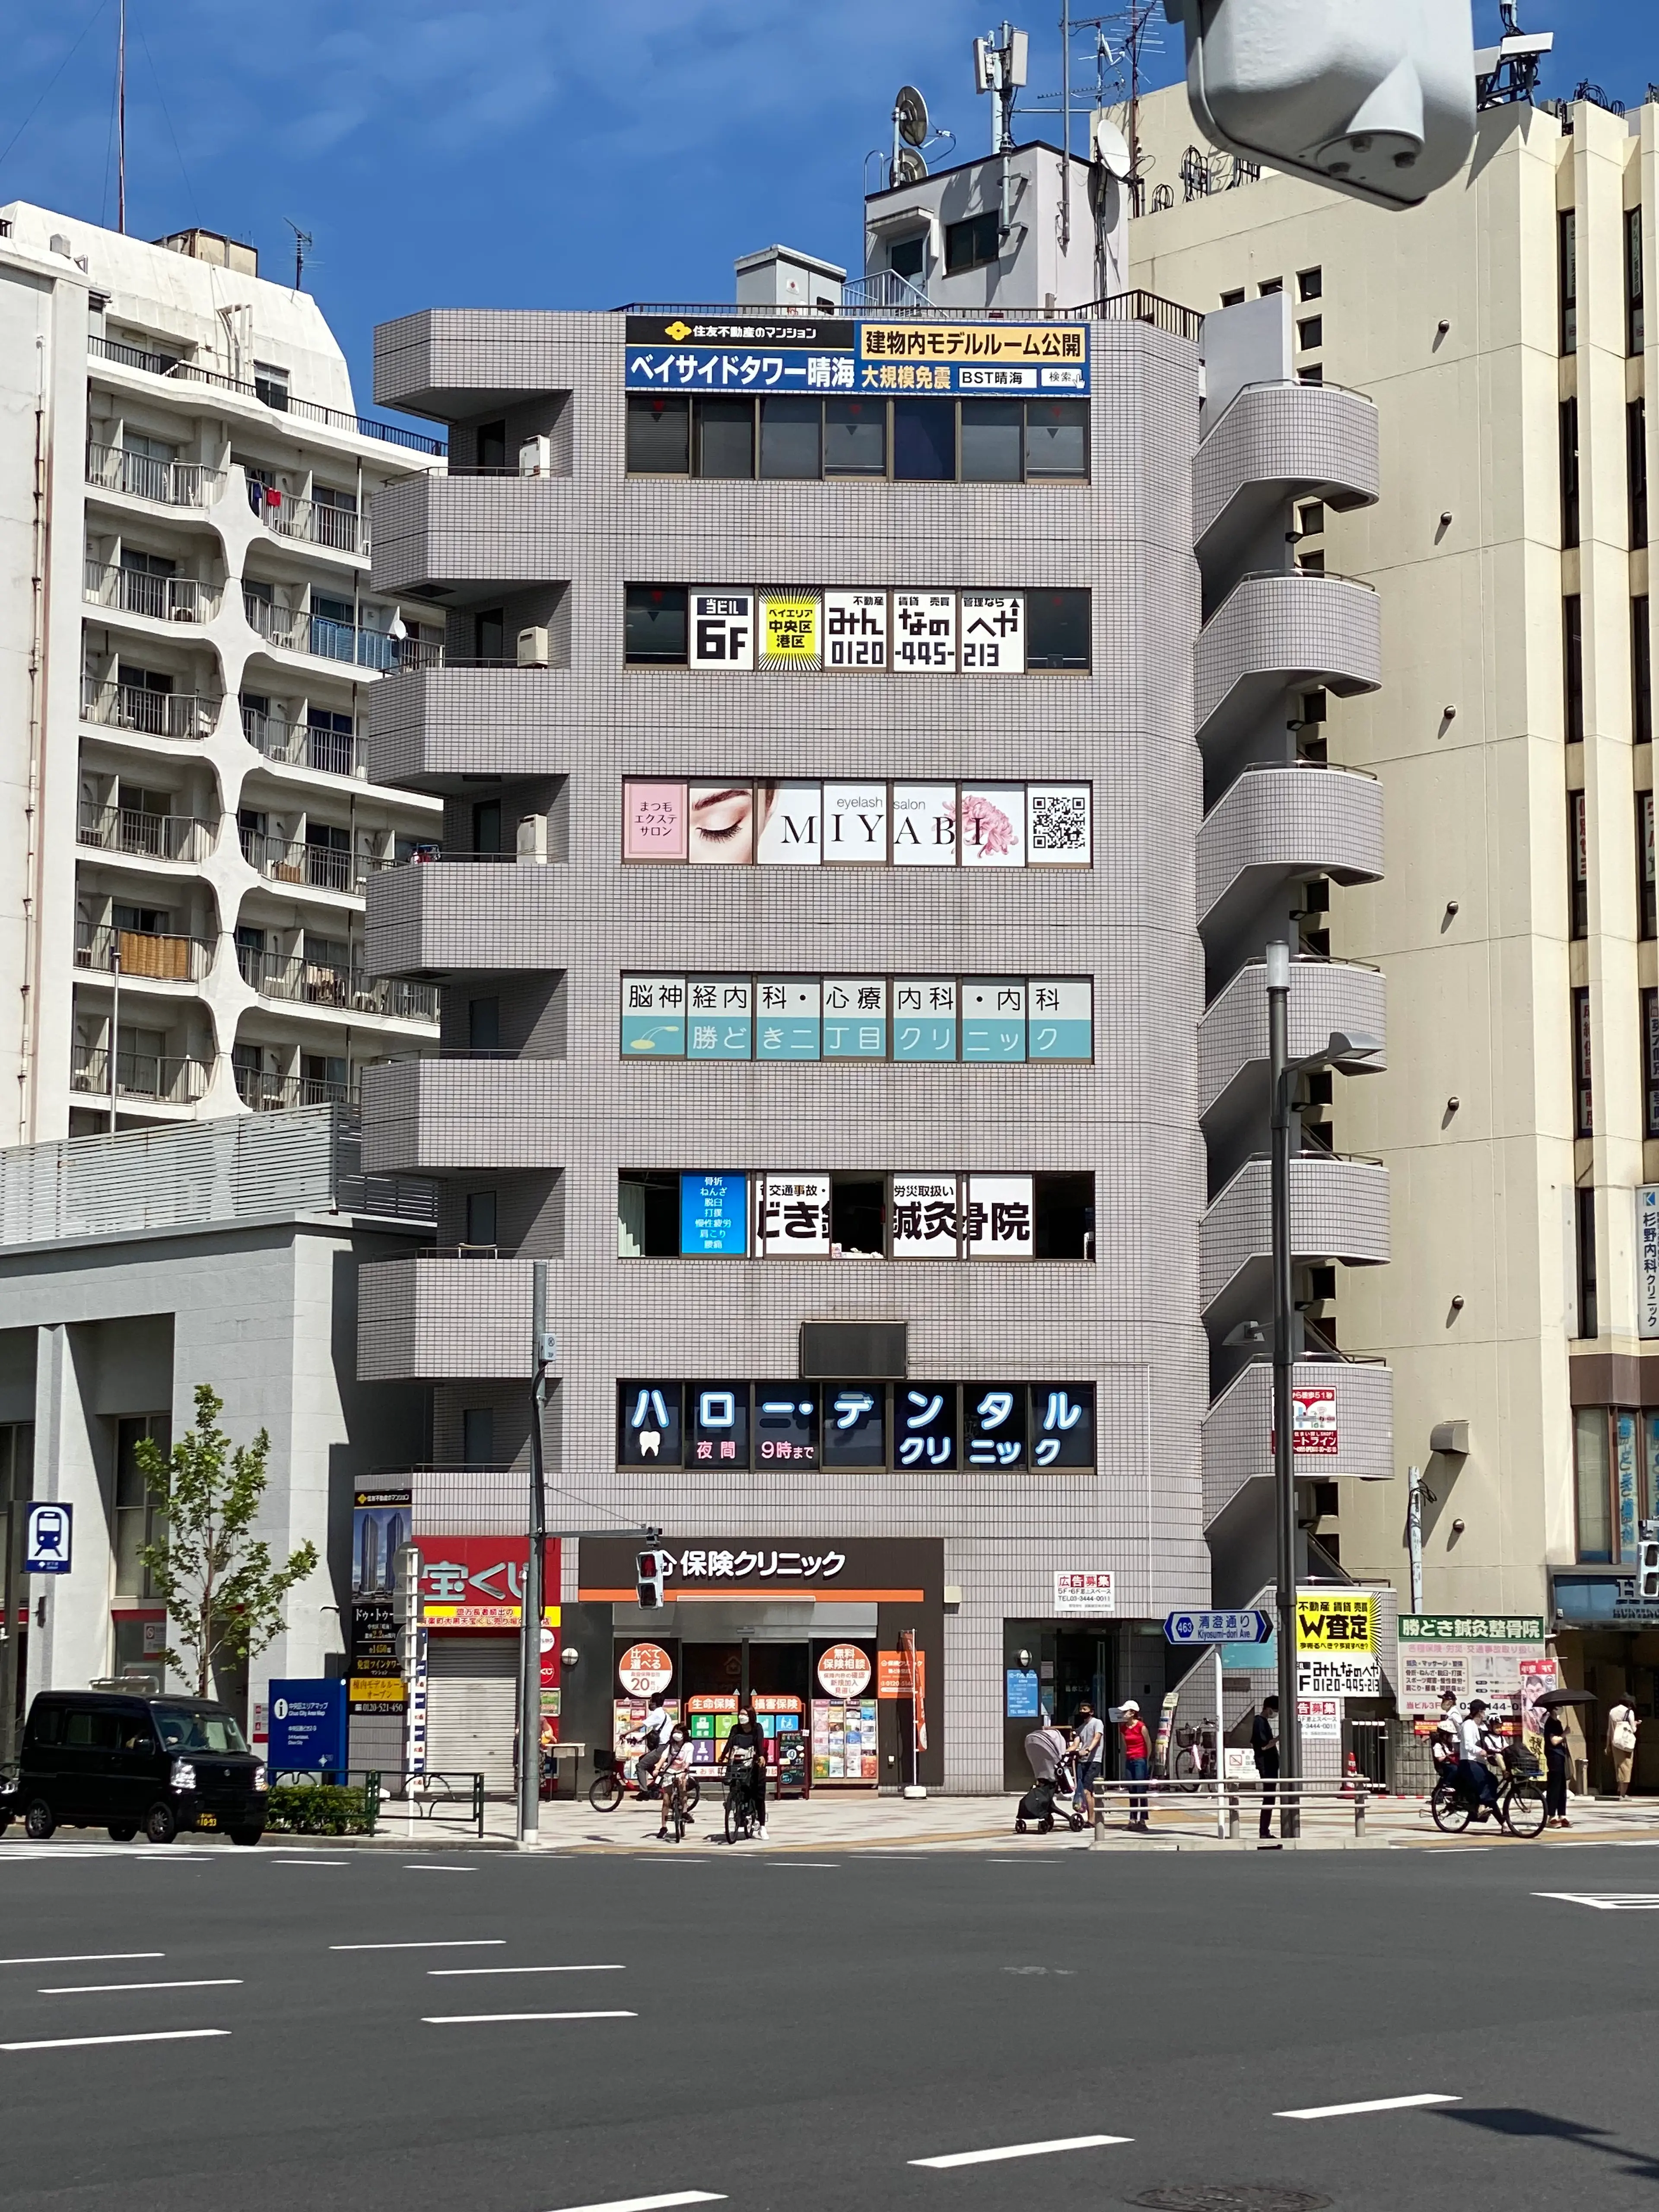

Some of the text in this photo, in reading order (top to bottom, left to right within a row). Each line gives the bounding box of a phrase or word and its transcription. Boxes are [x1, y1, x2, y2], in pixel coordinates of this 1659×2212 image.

[693, 326, 817, 339] 住友不動産のマンション
[866, 331, 1081, 357] 建物内モデルルーム公開
[631, 353, 855, 388] ベイサイドタワー晴海
[861, 365, 950, 389] 大規模免震
[962, 371, 1022, 384] BST晴海
[1049, 372, 1071, 382] 検索
[706, 598, 739, 614] 当ビル
[853, 596, 1004, 607] 不動産 賃貸 売買 管理なら
[769, 609, 813, 618] ベイエリア
[769, 620, 812, 633] 中央区
[697, 620, 748, 660] 6F
[776, 635, 805, 648] 港区
[640, 801, 672, 812] まつ毛
[836, 798, 926, 810] eyelash salon
[634, 814, 677, 825] エクステ
[640, 826, 672, 836] サロン
[781, 814, 986, 846] MIYABI
[705, 1177, 723, 1186] 骨折
[700, 1187, 728, 1197] ねんざ
[704, 1198, 722, 1207] 脱臼
[695, 1219, 732, 1228] 慢性疲労
[699, 1229, 726, 1239] 肩こり
[1643, 1211, 1657, 1327] 杉野内科クリニック
[696, 1440, 814, 1460] 夜間 9時まで
[899, 1437, 1061, 1465] クリニック
[680, 1551, 845, 1577] 保険クリニック
[1058, 1575, 1109, 1587] 広告募集
[1298, 1602, 1330, 1611] 不動産
[1333, 1602, 1351, 1612] 賃貸
[1178, 1622, 1192, 1633] 463
[1198, 1615, 1249, 1629] 清澄通り
[1299, 1614, 1368, 1640] W査定
[1198, 1629, 1238, 1640] Kiyosumi-dori
[1402, 1619, 1540, 1638] 勝どき鍼灸整骨院
[630, 1648, 662, 1659] 比べて
[834, 1648, 855, 1659] 無料
[630, 1659, 661, 1670] 選べる
[823, 1659, 866, 1669] 保険相談
[1313, 1662, 1378, 1677] みんなのへや
[631, 1678, 650, 1691] 20
[692, 1698, 736, 1710] 生命保険
[754, 1698, 798, 1710] 損害保険
